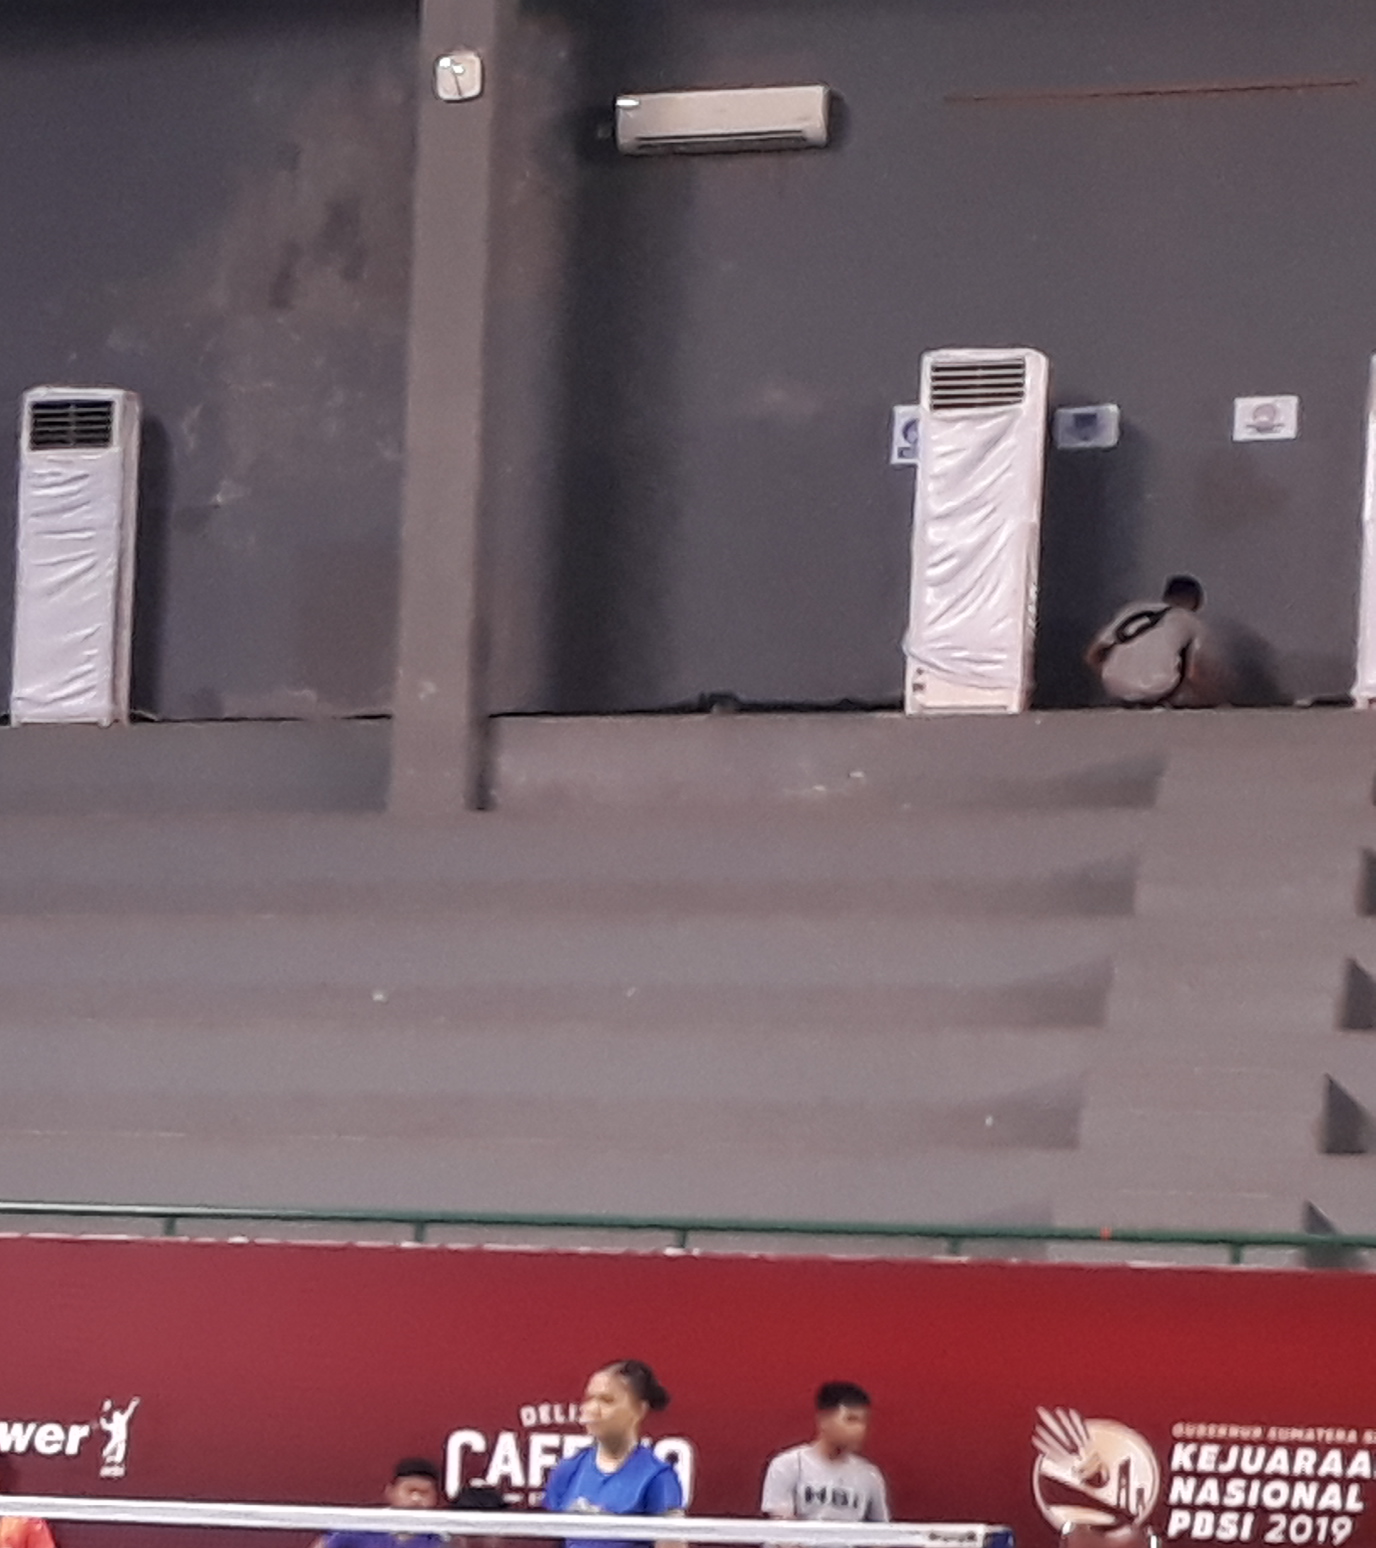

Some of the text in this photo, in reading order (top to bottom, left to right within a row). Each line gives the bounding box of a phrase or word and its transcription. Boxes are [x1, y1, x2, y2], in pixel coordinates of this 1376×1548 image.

[1171, 1442, 1376, 1478] KEJUARAA
[1168, 1476, 1364, 1512] NASIONAL
[1263, 1513, 1353, 1546] 2019
